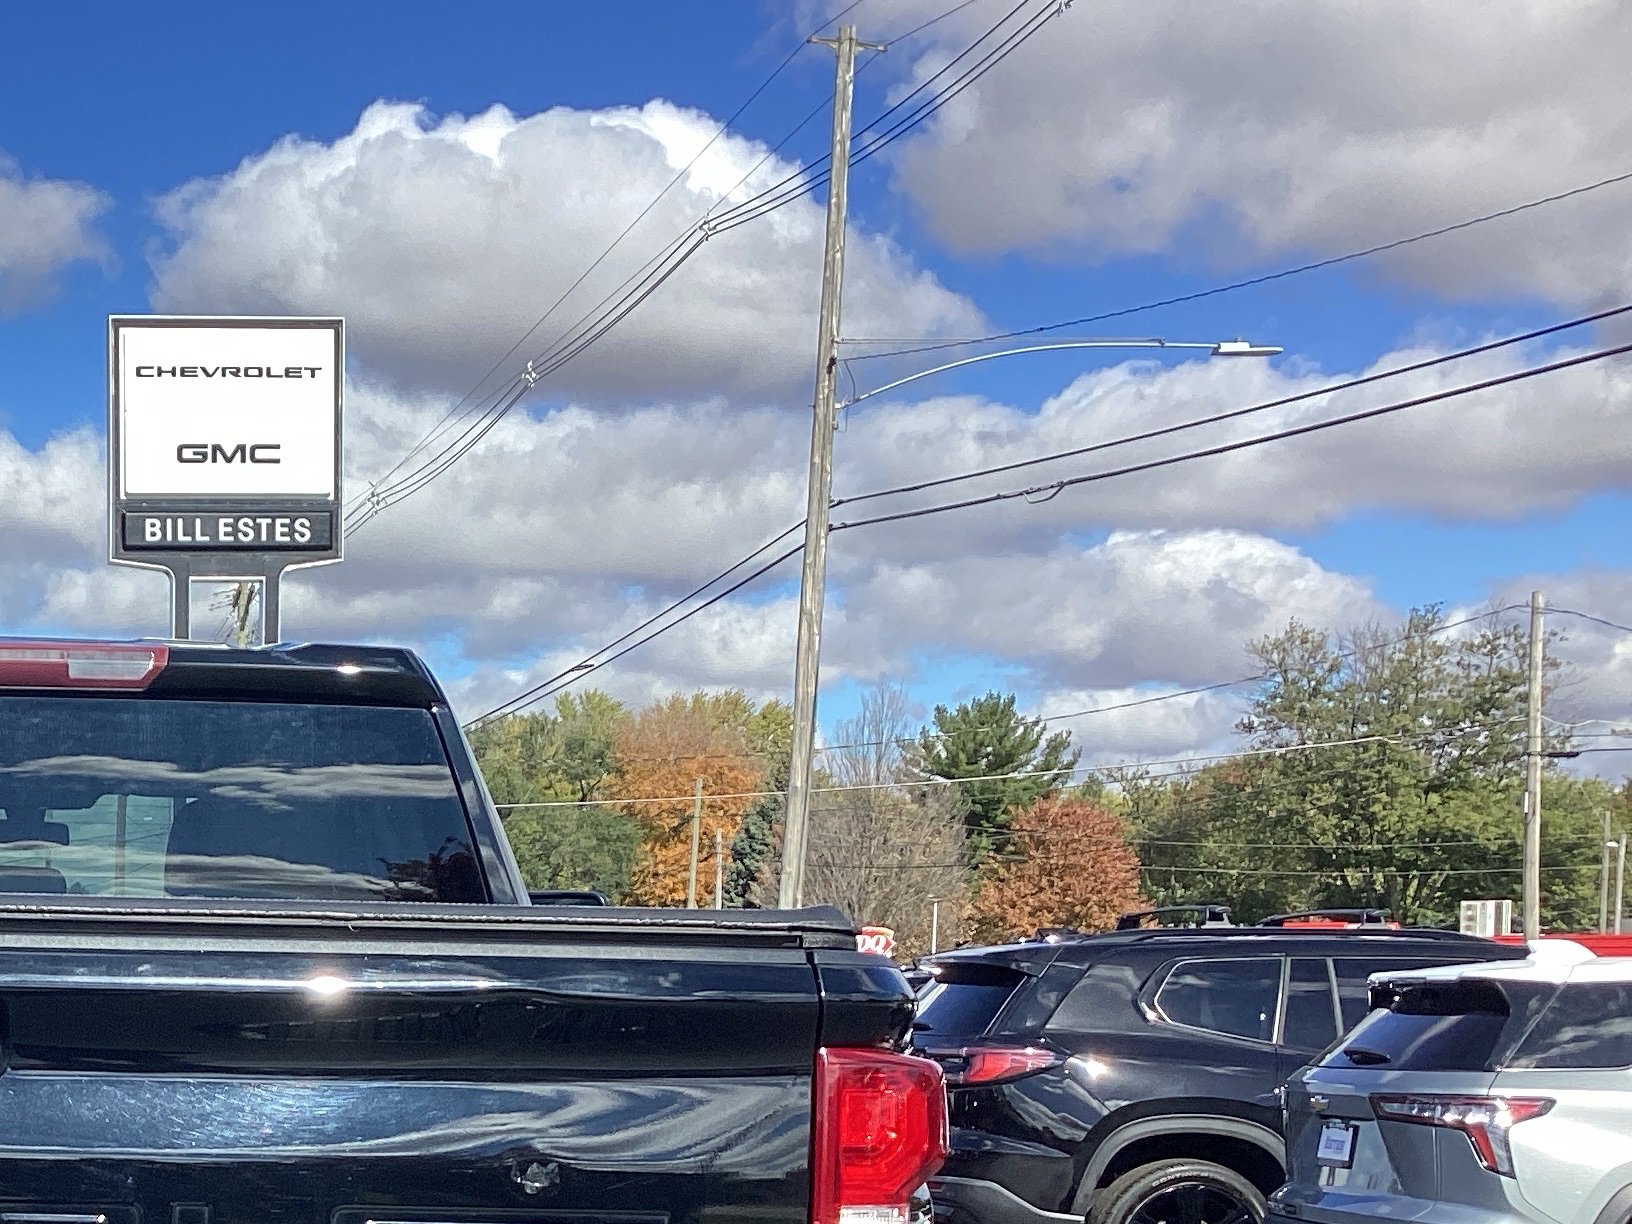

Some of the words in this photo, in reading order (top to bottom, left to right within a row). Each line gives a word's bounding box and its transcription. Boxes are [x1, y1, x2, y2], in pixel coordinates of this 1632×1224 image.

[135, 365, 322, 379] CHEVROLET
[176, 443, 281, 464] GMC
[144, 518, 210, 542] BILL
[219, 518, 311, 543] ESTES
